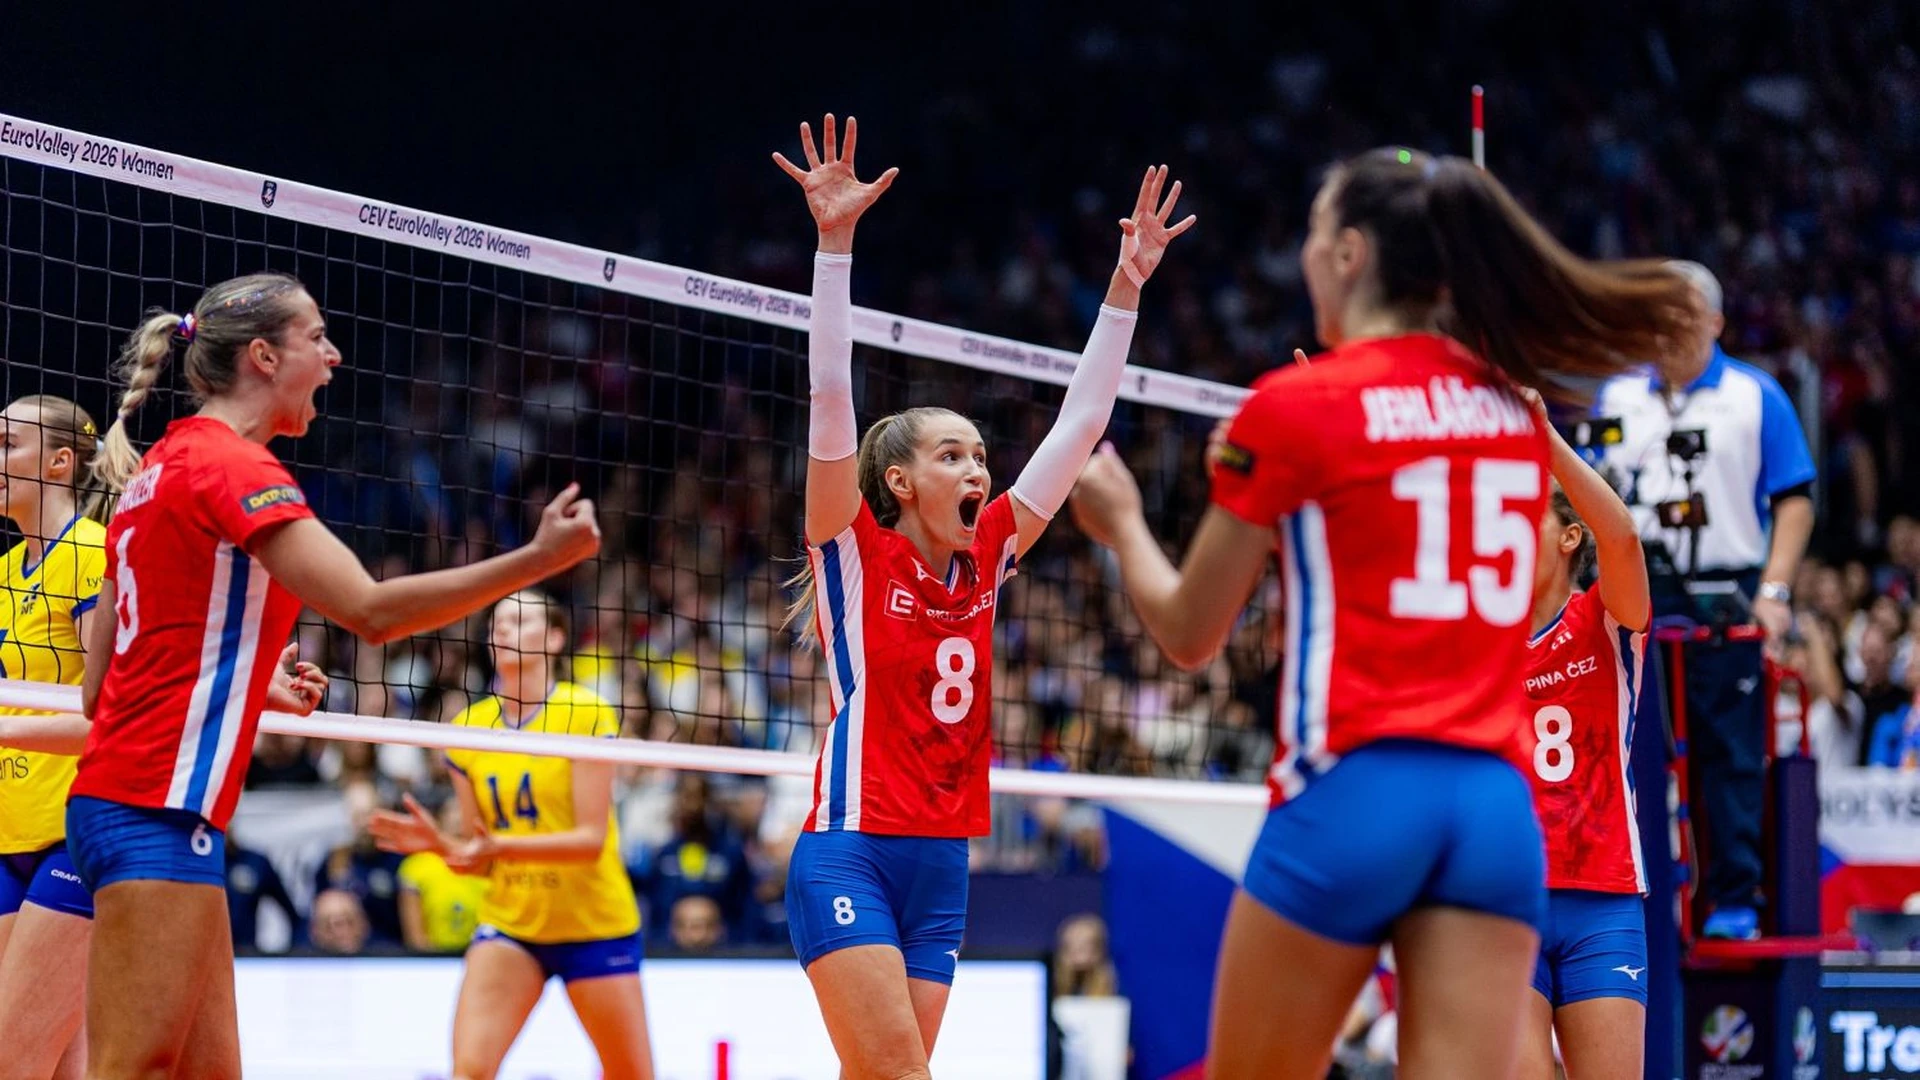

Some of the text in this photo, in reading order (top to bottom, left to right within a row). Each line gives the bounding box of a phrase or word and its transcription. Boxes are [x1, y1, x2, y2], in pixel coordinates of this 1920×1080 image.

[0, 121, 174, 180] EuroVolley 2026 Women
[359, 204, 531, 259] CEV EuroVolley 2026 Women
[684, 276, 709, 297] CEV
[709, 281, 763, 314] EuroVolley
[1389, 455, 1541, 628] 15
[114, 526, 140, 656] 6
[931, 636, 976, 724] 8
[1566, 655, 1599, 679] ČEZ
[1533, 705, 1575, 782] 8
[487, 772, 540, 829] 14
[190, 823, 213, 856] 6
[832, 896, 856, 925] 8
